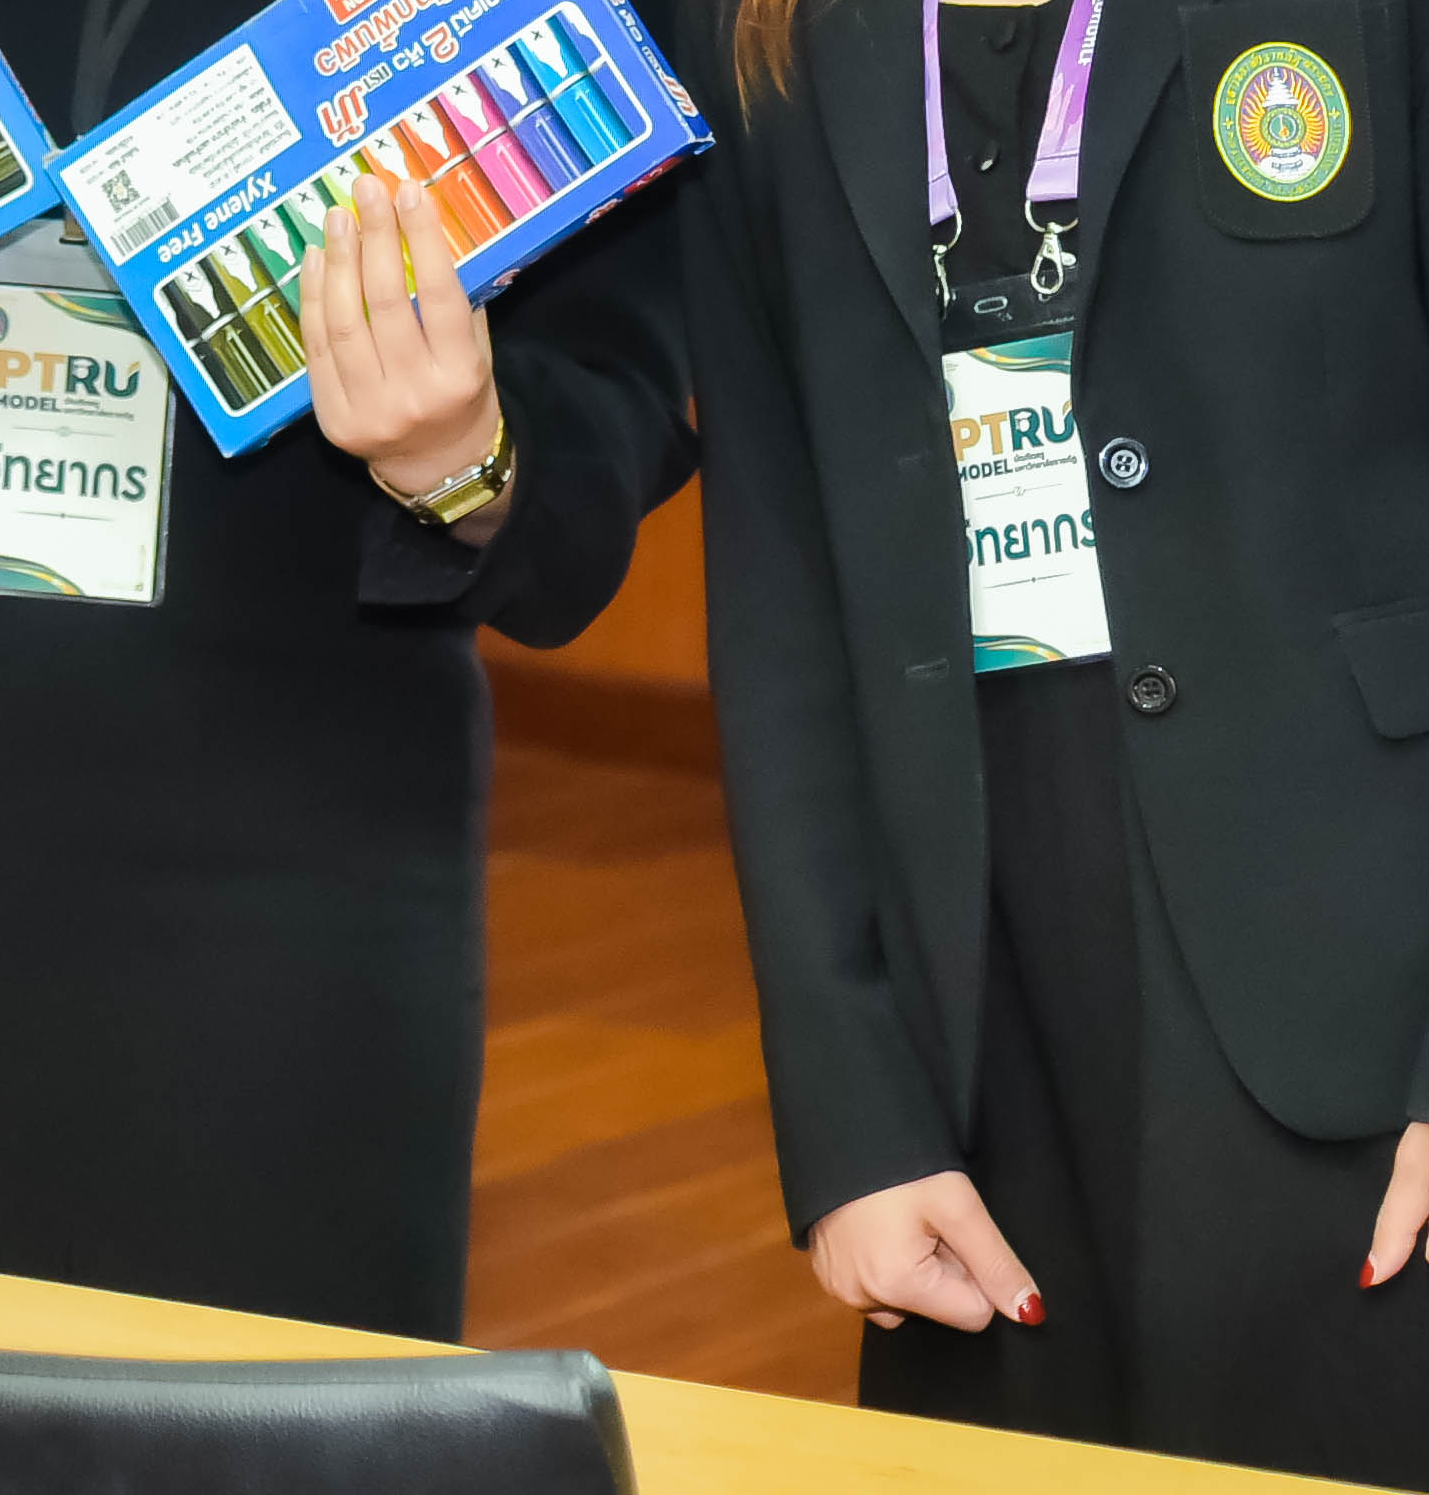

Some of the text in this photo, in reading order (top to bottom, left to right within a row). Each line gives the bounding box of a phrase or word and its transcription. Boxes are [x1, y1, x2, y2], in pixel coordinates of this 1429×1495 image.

[392, 41, 425, 71] หัว
[422, 22, 460, 63] 2
[204, 171, 277, 230] Xylene
[157, 222, 204, 263] Free
[950, 400, 1075, 462] PTRU
[958, 458, 1013, 481] MODEL
